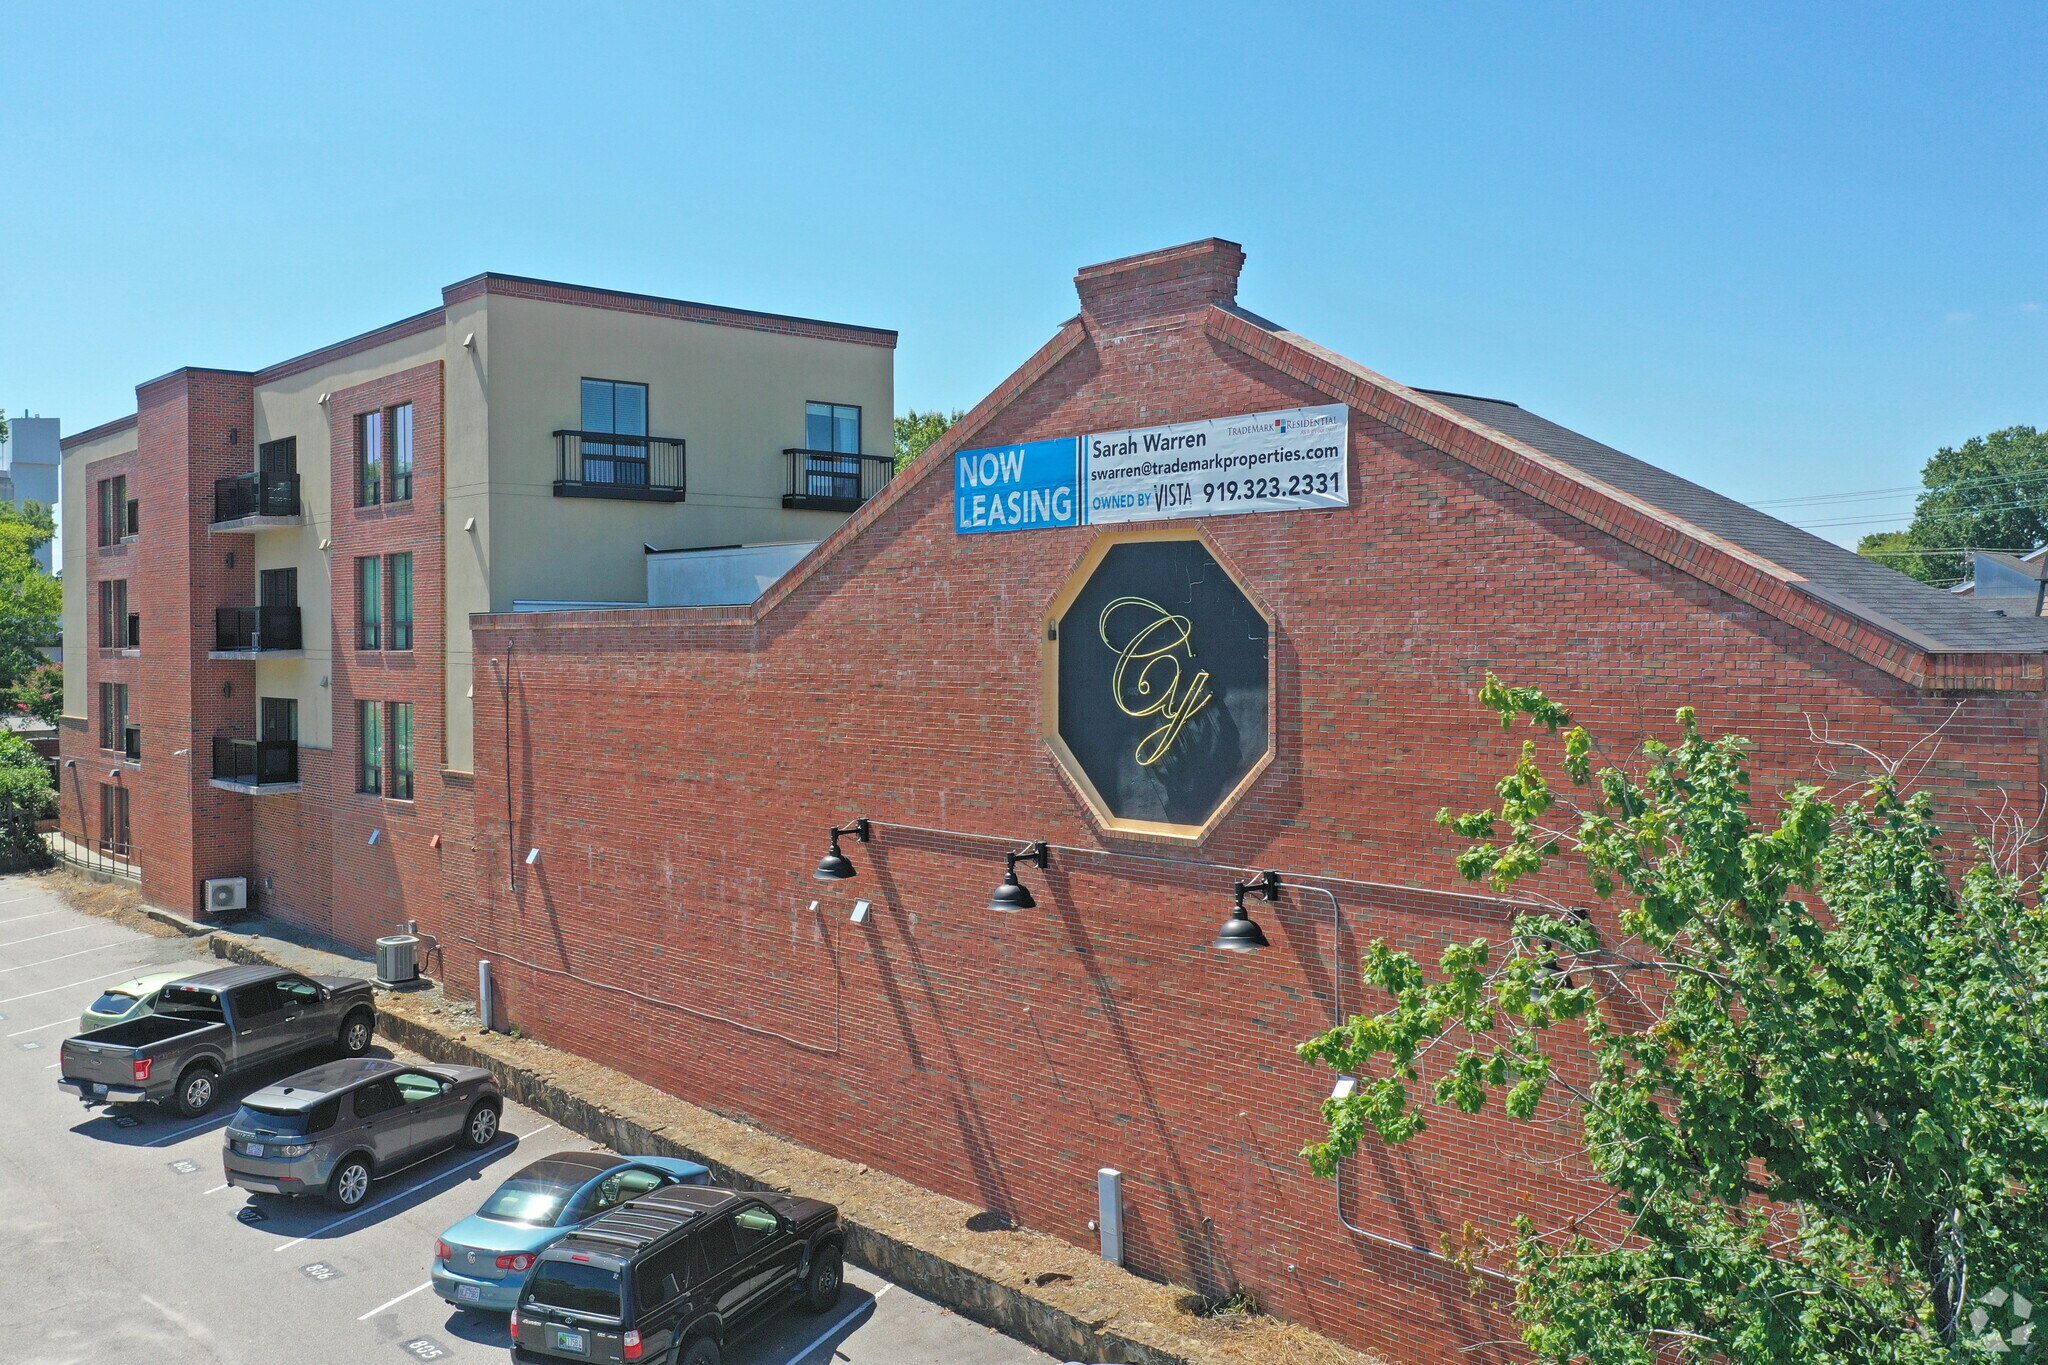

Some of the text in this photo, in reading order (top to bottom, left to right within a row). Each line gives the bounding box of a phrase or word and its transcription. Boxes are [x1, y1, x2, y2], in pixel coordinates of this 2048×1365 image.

[1092, 433, 1206, 458] Sarah Warren
[960, 449, 1025, 488] NOW
[1091, 446, 1339, 481] swarren@trademarkproperties.com
[1092, 482, 1192, 512] OWNED BY VISTA
[1203, 472, 1339, 503] 919.323.2331
[960, 486, 1072, 528] LEASING
[306, 1264, 334, 1280] 806
[409, 1340, 443, 1358] 805
